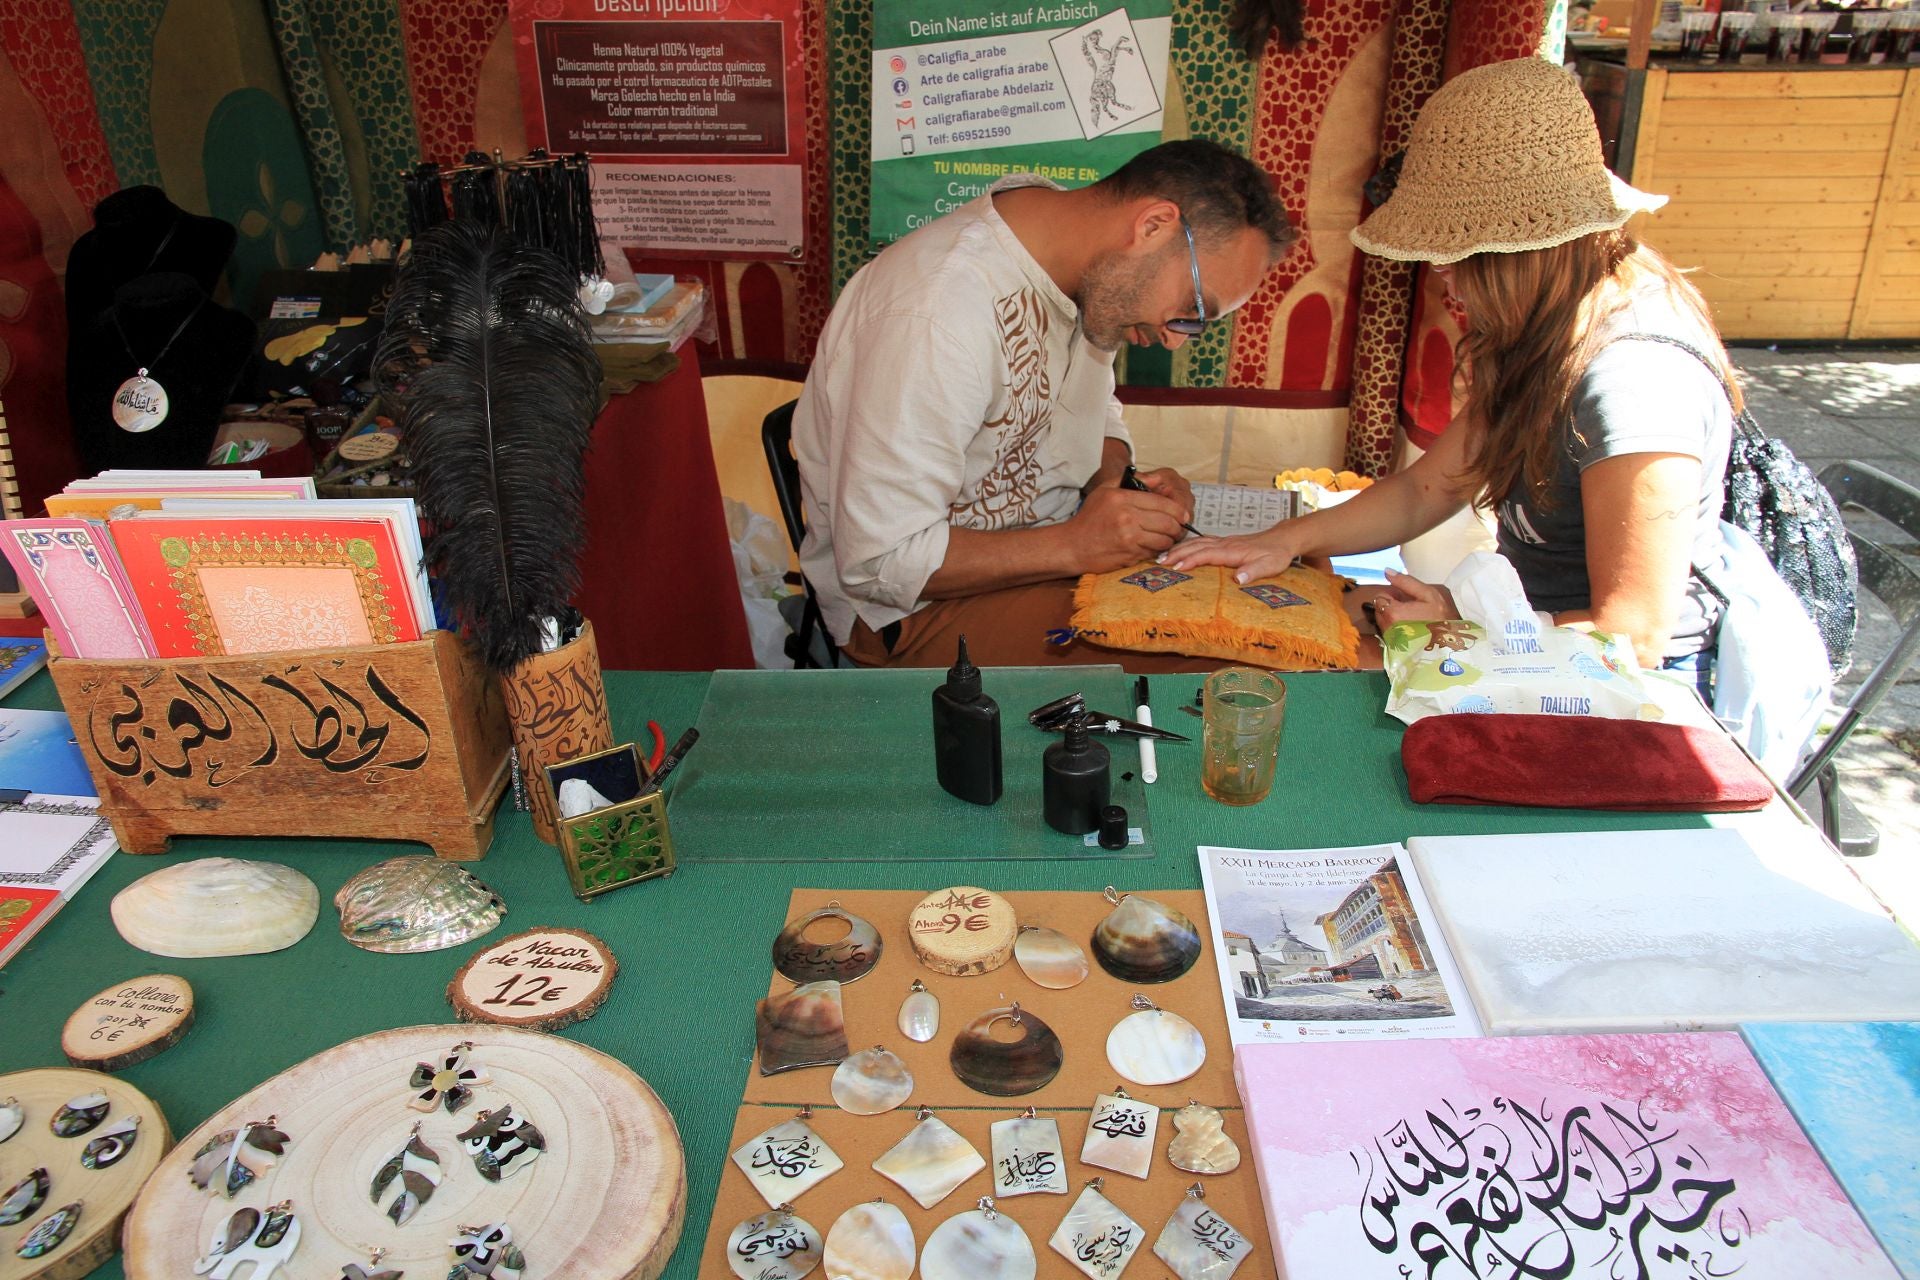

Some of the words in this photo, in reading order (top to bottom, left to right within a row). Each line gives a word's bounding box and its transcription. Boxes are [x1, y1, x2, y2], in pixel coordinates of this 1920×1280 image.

[909, 20, 943, 37] Dein
[946, 16, 988, 33] Name
[990, 12, 1006, 28] ist
[1011, 8, 1033, 25] auf
[1036, 4, 1098, 23] Arabisch
[593, 43, 622, 56] Henna
[624, 43, 659, 56] Natural
[661, 43, 687, 56] 100%
[689, 43, 724, 59] Vegetal
[660, 60, 674, 71] sin
[676, 59, 723, 73] productos
[552, 74, 564, 86] Ha
[566, 74, 595, 88] pasado
[597, 77, 611, 88] por
[614, 75, 621, 86] el
[709, 75, 719, 87] de
[721, 75, 772, 87] ADTPostales
[921, 74, 943, 86] Arte
[946, 71, 960, 82] de
[590, 88, 619, 101] Marca
[621, 88, 657, 101] Golecha
[659, 88, 687, 101] hecho
[690, 91, 700, 101] en
[703, 88, 711, 101] la
[714, 88, 736, 101] India
[922, 86, 999, 106] Caligrafiarabe
[1002, 80, 1054, 96] Abdelaziz
[607, 103, 632, 116] Color
[634, 105, 669, 116] marrón
[671, 104, 718, 116] traditional
[925, 100, 1066, 127] caligrafiarabe@gmail.com
[927, 133, 949, 145] Telf:
[952, 126, 1011, 142] 669521590
[605, 173, 736, 182] RECOMENDACIONES:
[934, 161, 950, 174] TU
[953, 162, 1009, 176] NOMBRE
[1012, 163, 1030, 174] EN
[1033, 163, 1077, 180] ÁRABE
[1079, 168, 1100, 181] EN:
[615, 188, 639, 196] limpiar
[711, 190, 737, 198] aplicar
[934, 198, 963, 213] Cart
[692, 218, 705, 226] piel
[906, 215, 932, 229] Coll
[737, 238, 754, 246] agua
[317, 426, 342, 434] JOOP!
[1540, 696, 1591, 715] TOALLITAS
[1220, 857, 1252, 867] XXII
[917, 902, 944, 910] Antes
[914, 920, 945, 929] Ahora
[487, 953, 518, 966] de
[117, 986, 180, 1004] Collares
[482, 973, 569, 1006] 12€
[95, 998, 116, 1006] con
[120, 999, 136, 1008] tu
[140, 1003, 184, 1014] nombre
[105, 1015, 128, 1024] por
